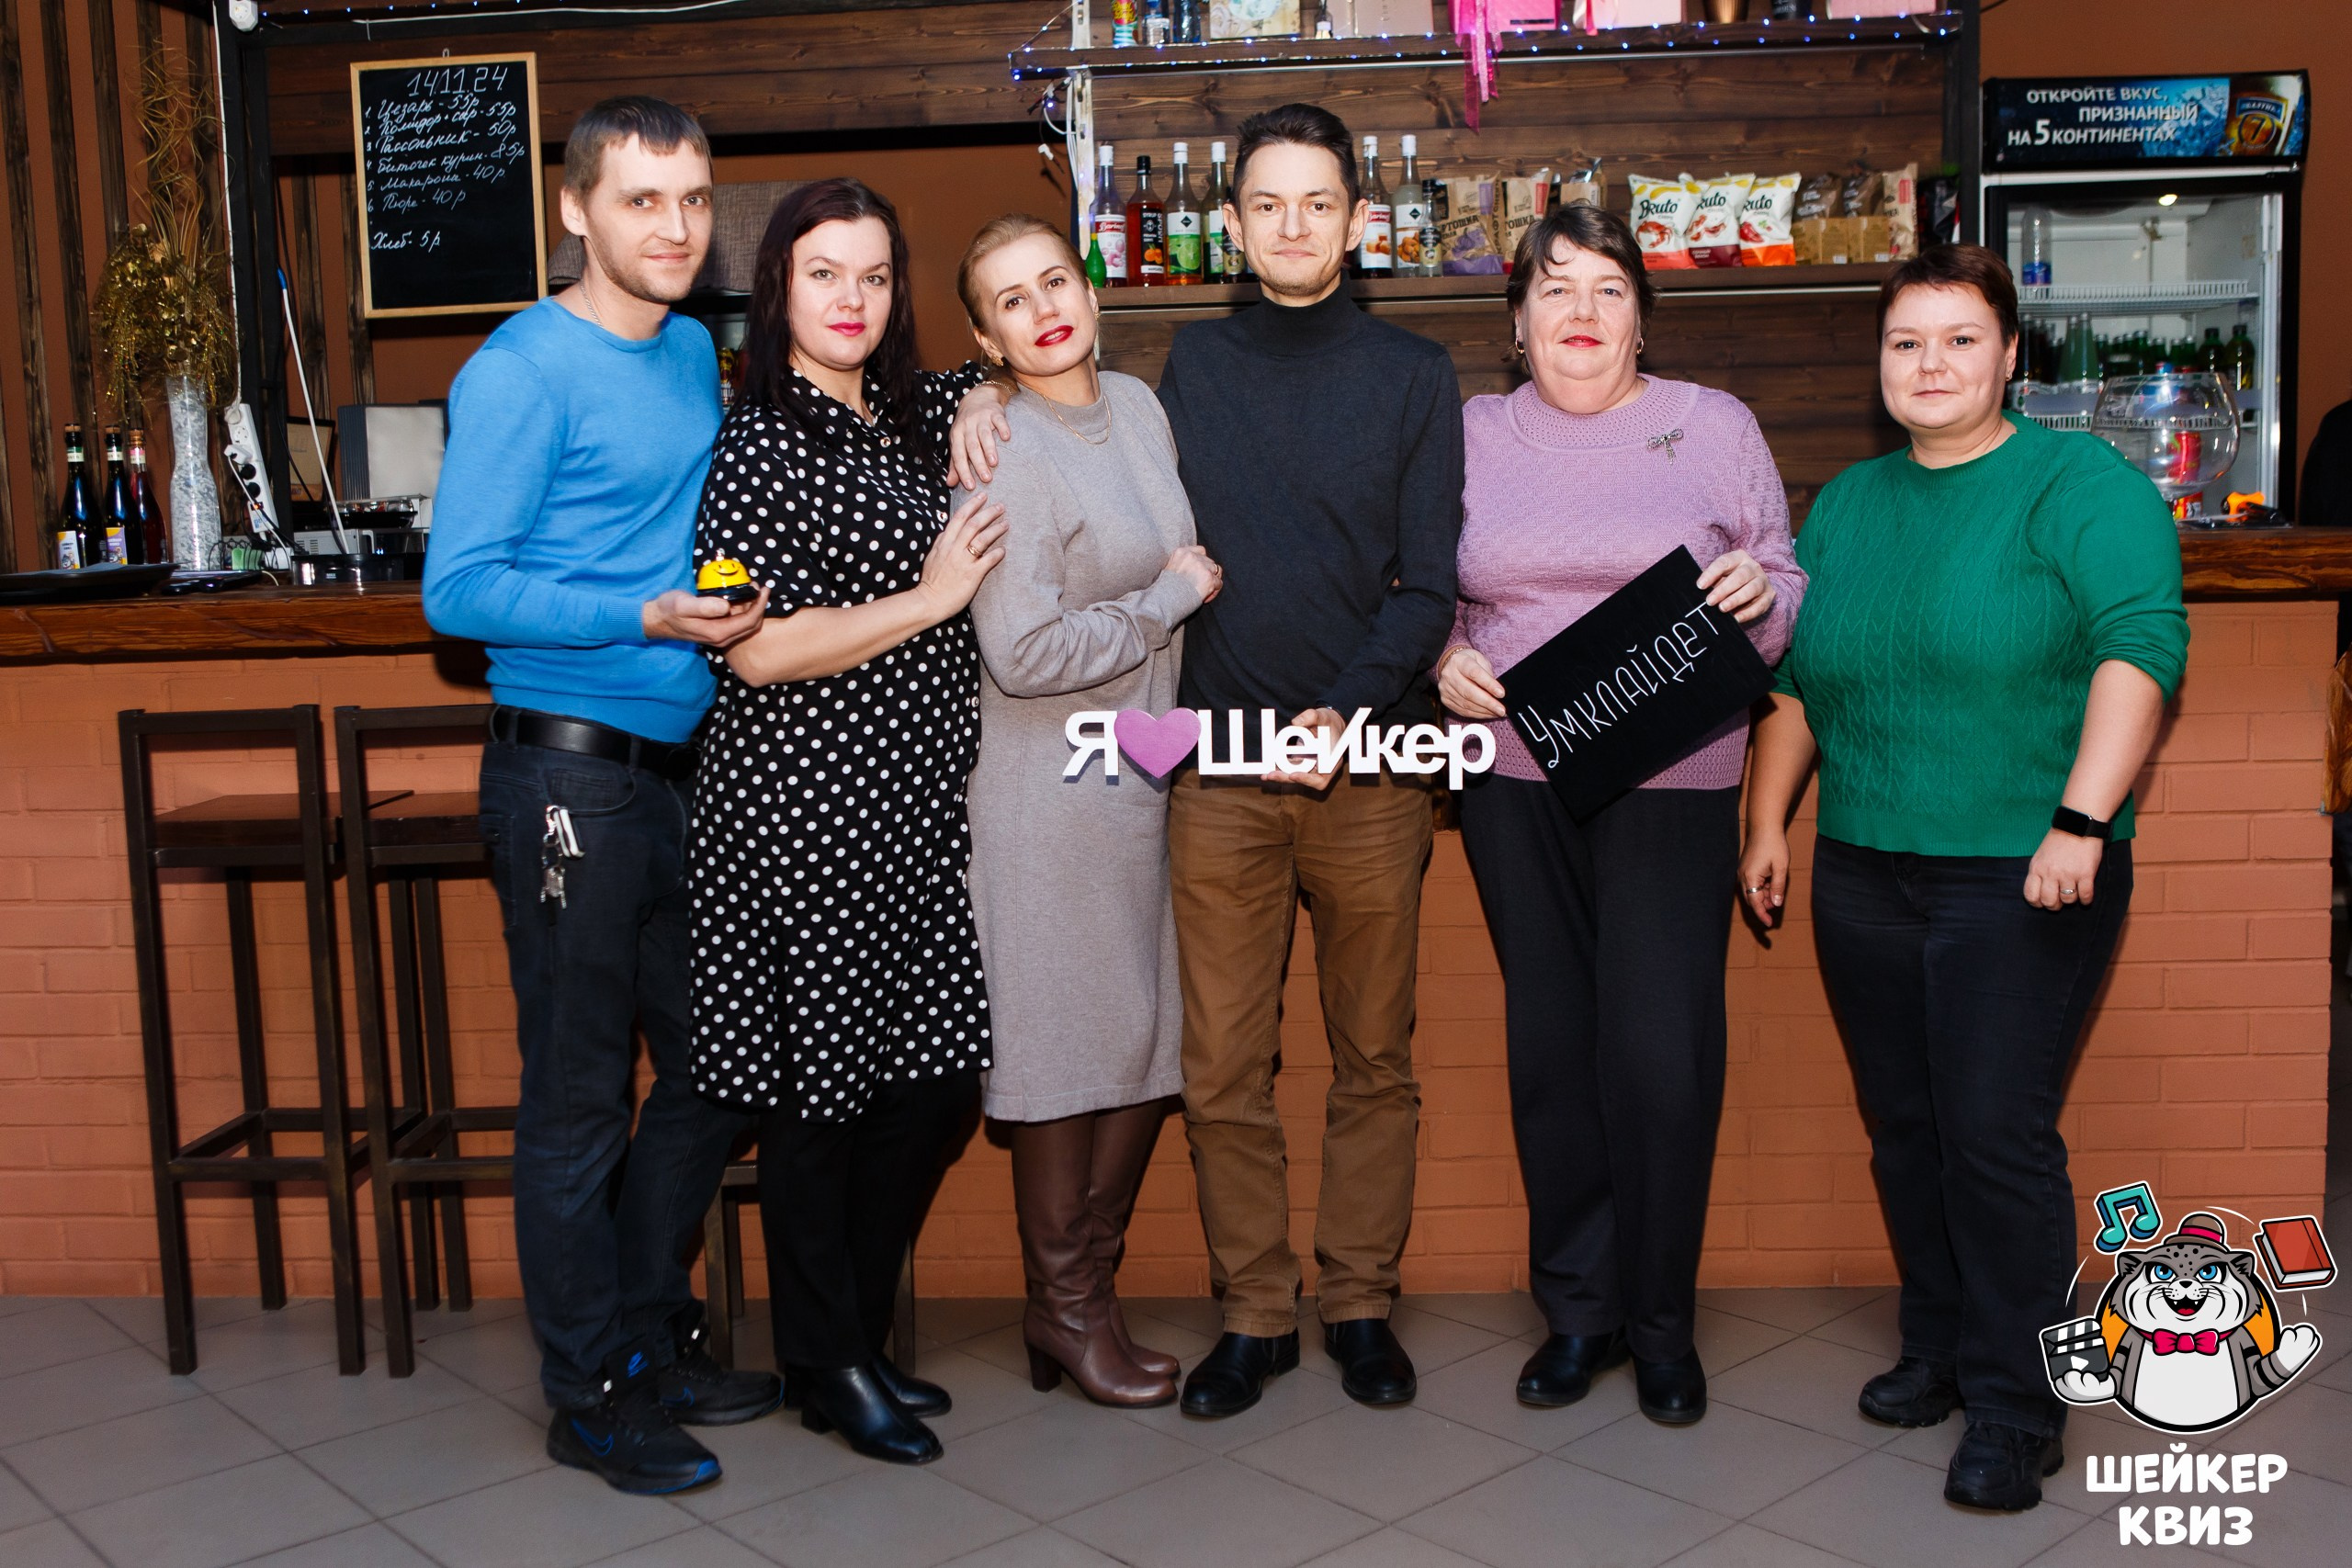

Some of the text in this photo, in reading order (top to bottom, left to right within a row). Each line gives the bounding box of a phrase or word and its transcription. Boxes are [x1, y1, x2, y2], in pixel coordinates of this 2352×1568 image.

[2027, 86, 2169, 104] ОТКРОЙТЕ ВКУС,
[378, 98, 432, 124] Цезарь
[2079, 103, 2199, 123] ПРИЗНАННЫЙ
[2007, 119, 2177, 146] НА 5 КОНТИНЕНТАХ
[2251, 117, 2267, 141] 7
[375, 129, 471, 154] Рассольник
[1696, 192, 1727, 210] ruto
[1743, 195, 1772, 211] ruto
[1062, 707, 1497, 790] Я Шейкер
